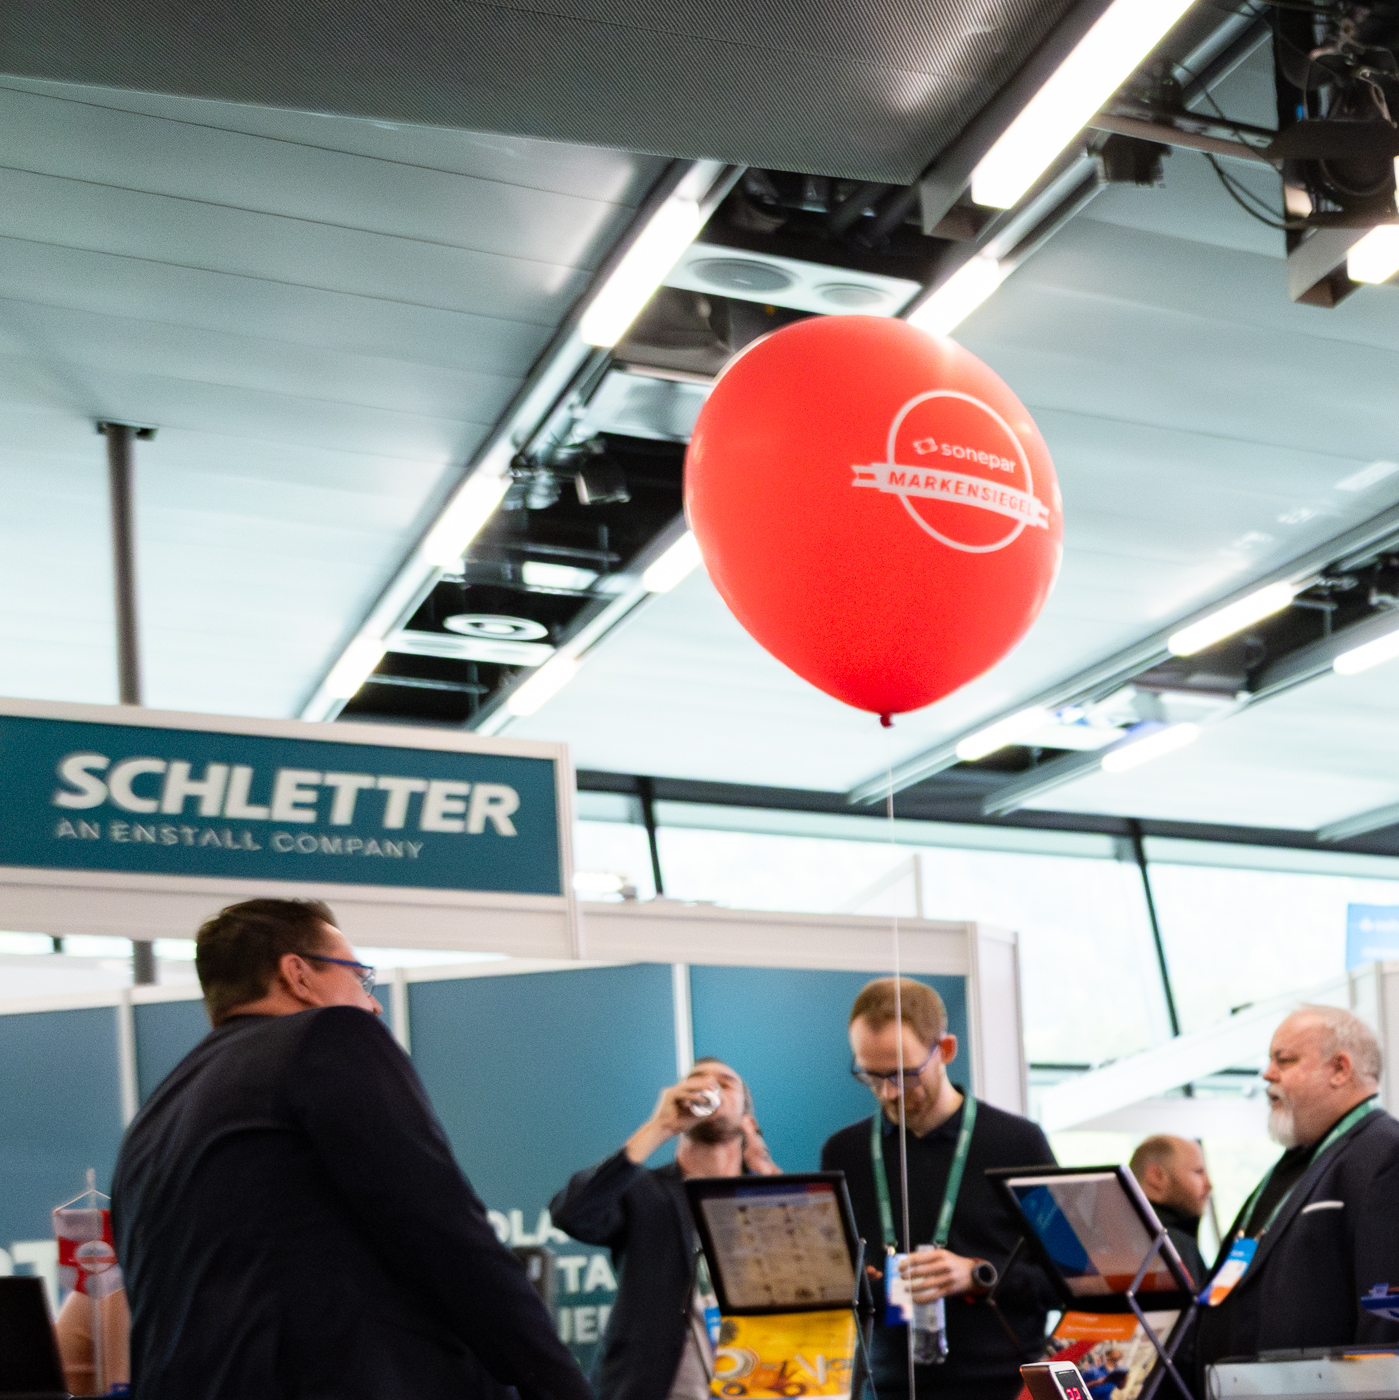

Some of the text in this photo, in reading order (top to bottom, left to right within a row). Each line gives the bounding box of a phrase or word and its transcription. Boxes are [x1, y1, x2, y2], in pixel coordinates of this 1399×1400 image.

[941, 442, 1016, 474] sonepar
[888, 470, 1034, 517] MARKENSIEGEL
[53, 750, 521, 838] SCHLETTER
[55, 818, 424, 860] AN ENSTALL COMPANY
